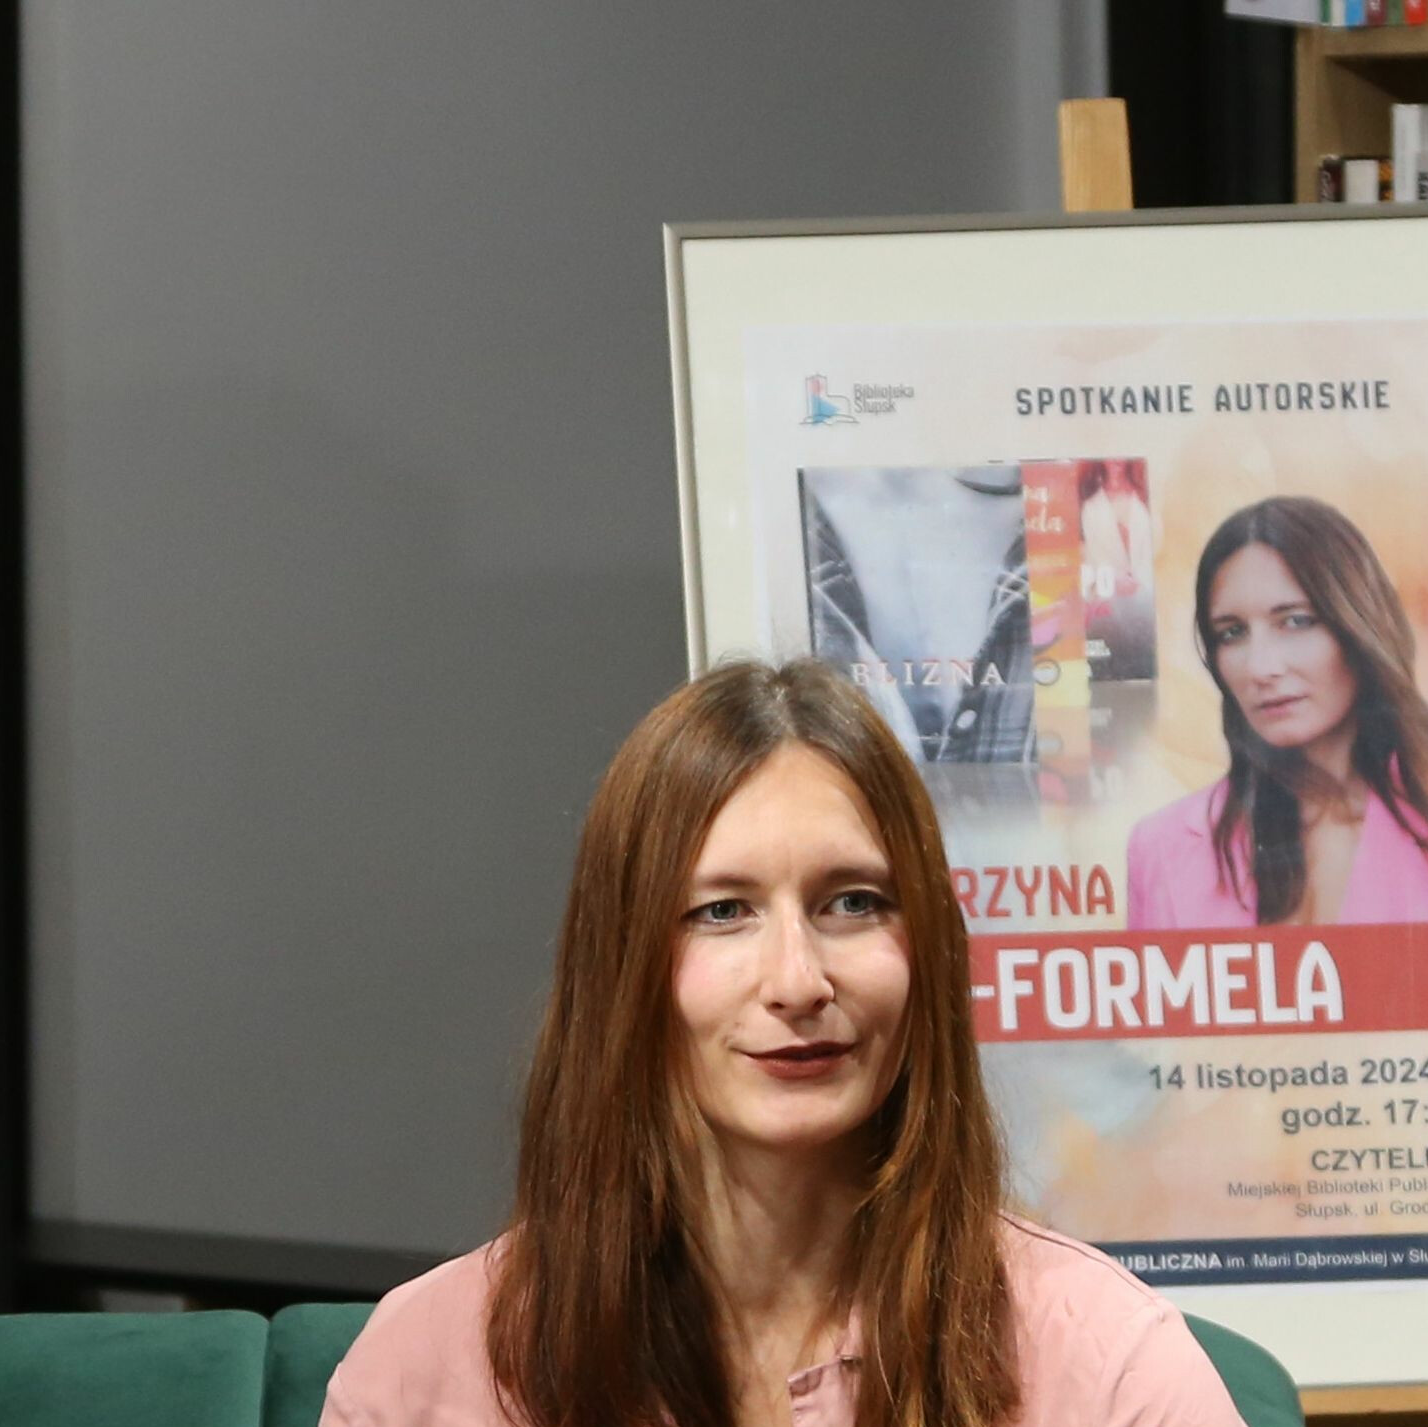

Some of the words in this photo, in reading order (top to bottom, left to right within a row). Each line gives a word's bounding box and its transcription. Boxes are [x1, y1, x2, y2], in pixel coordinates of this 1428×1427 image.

[853, 383, 915, 401] Biblioteka
[1015, 384, 1194, 417] SPOTKANIE
[1214, 379, 1392, 412] AUTORSKIE
[850, 659, 1007, 688] BLIZNA
[1148, 1065, 1186, 1091] 14
[1196, 1060, 1350, 1096] listopada
[1281, 1102, 1371, 1134] godz.
[1227, 1181, 1302, 1200] Miejskiej
[1306, 1178, 1383, 1195] Biblioteki
[1253, 1252, 1291, 1267] Marii
[1294, 1249, 1388, 1270] Dąbrowskiej
[1390, 1251, 1405, 1263] w
